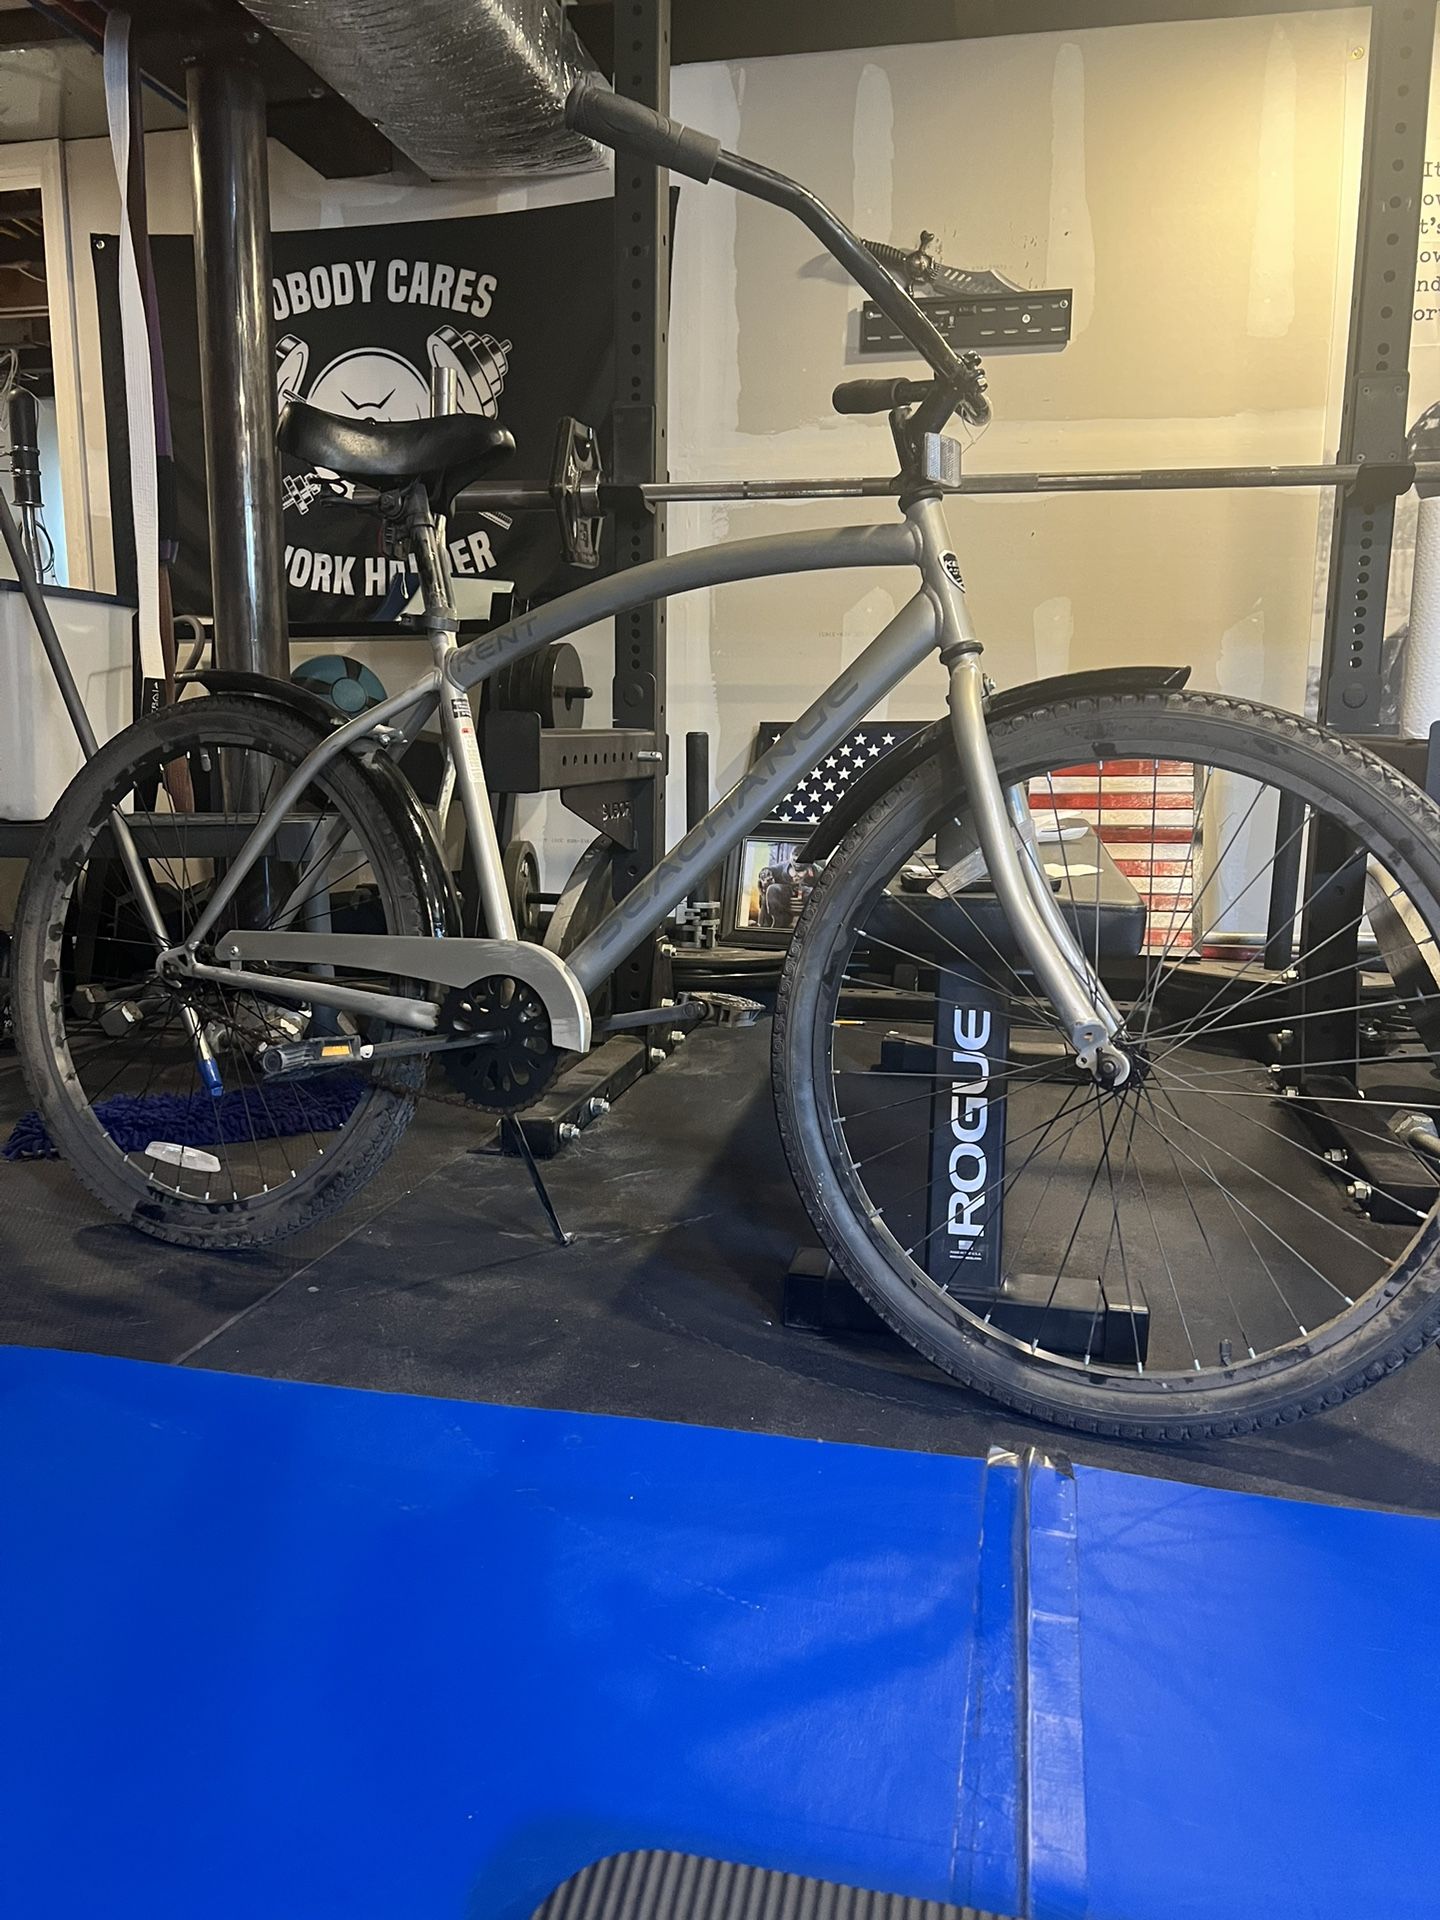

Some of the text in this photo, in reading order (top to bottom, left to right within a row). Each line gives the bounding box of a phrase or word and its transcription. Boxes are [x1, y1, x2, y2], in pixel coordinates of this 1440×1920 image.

[272, 259, 498, 321] OBODY CARES
[457, 615, 538, 673] KENT
[948, 1008, 991, 1237] ROGUE
